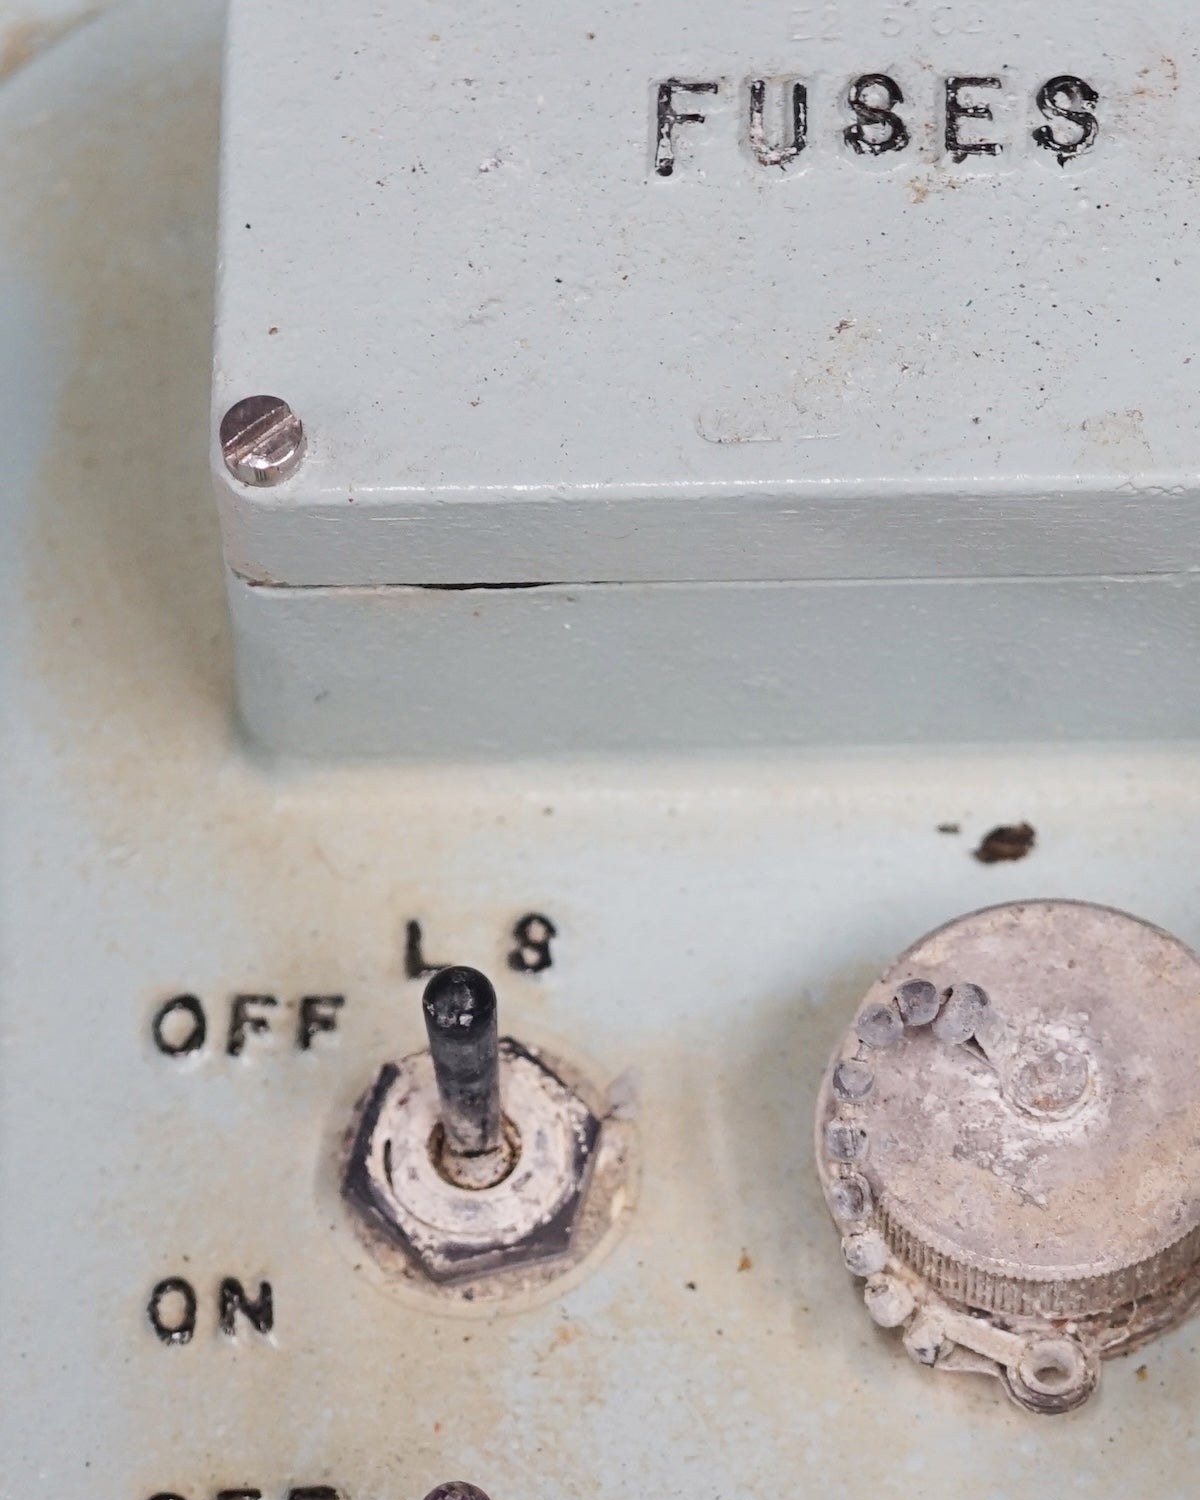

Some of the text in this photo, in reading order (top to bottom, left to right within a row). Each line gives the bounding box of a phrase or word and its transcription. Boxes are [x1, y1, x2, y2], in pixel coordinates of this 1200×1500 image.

[655, 73, 1098, 177] FUSES
[152, 994, 345, 1057] OFF
[147, 1277, 274, 1345] ON
